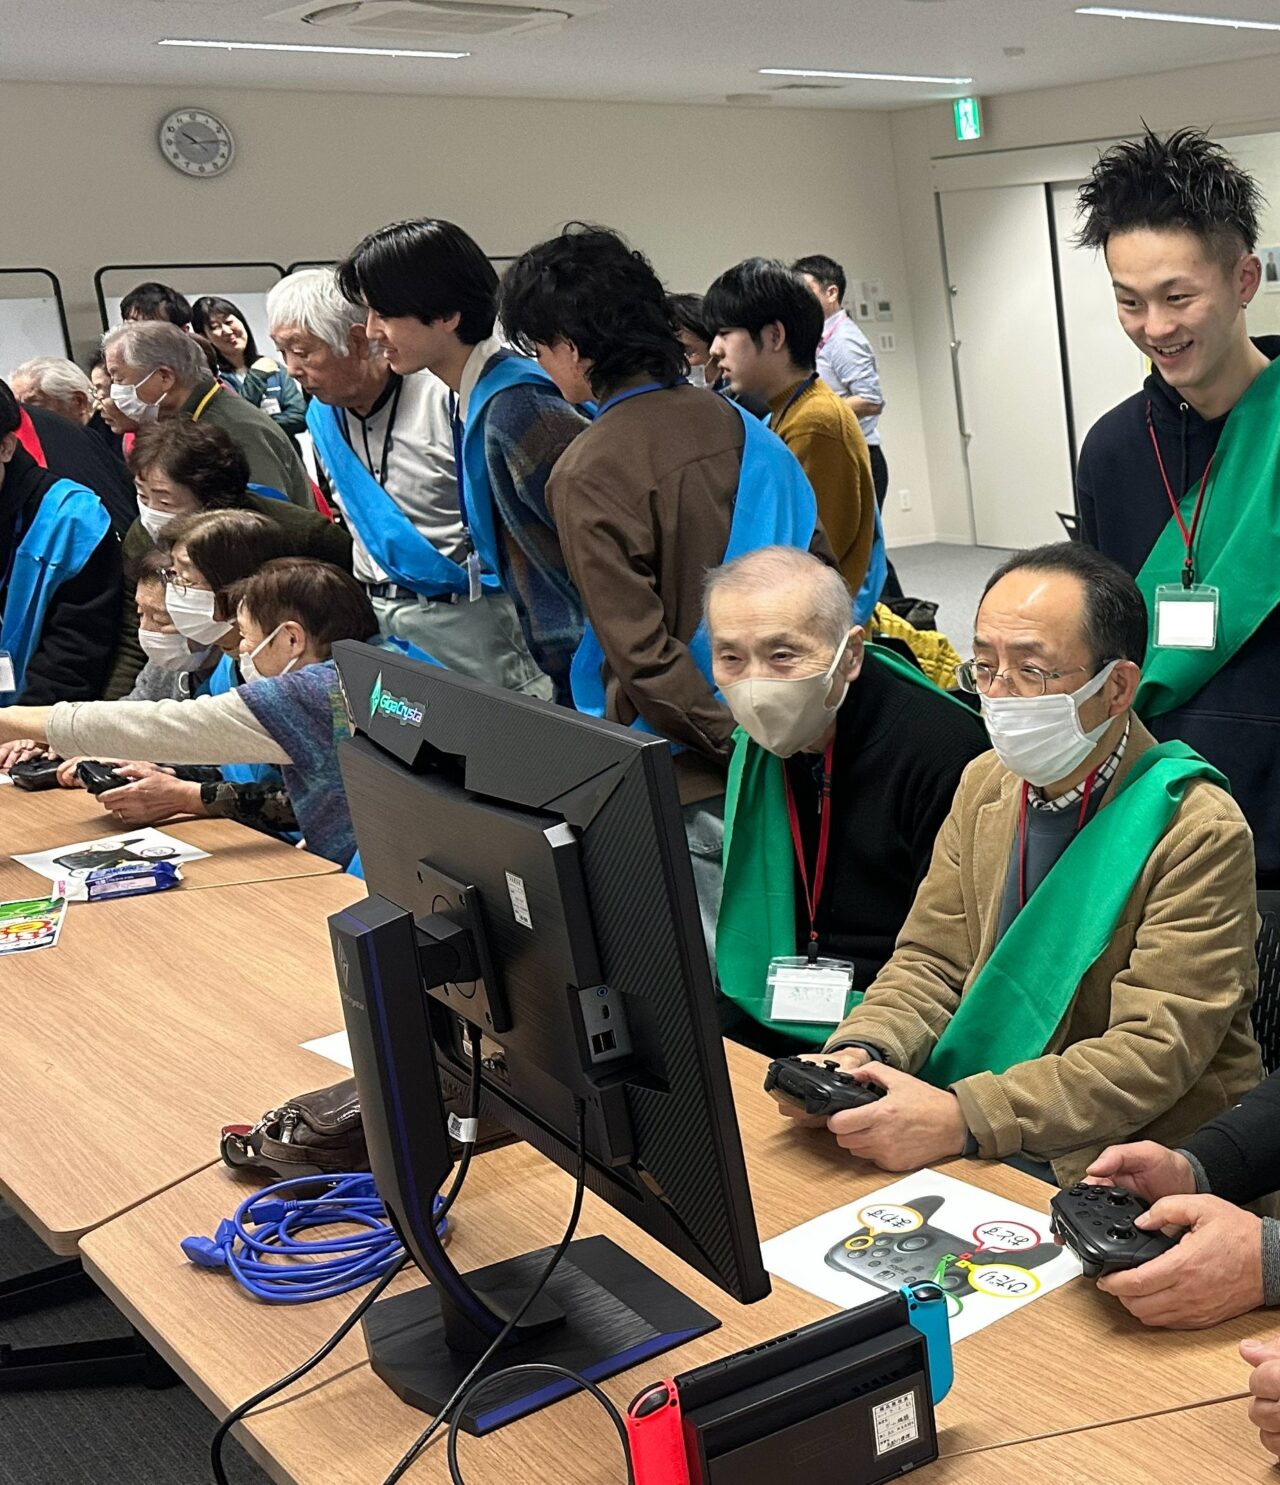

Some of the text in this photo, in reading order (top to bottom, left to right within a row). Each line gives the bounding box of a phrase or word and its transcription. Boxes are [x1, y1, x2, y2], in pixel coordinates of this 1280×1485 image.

[380, 693, 424, 724] GigaCrysta
[867, 1208, 912, 1228] まわす
[982, 1225, 1030, 1247] おとす
[978, 1270, 1028, 1294] ひだり
